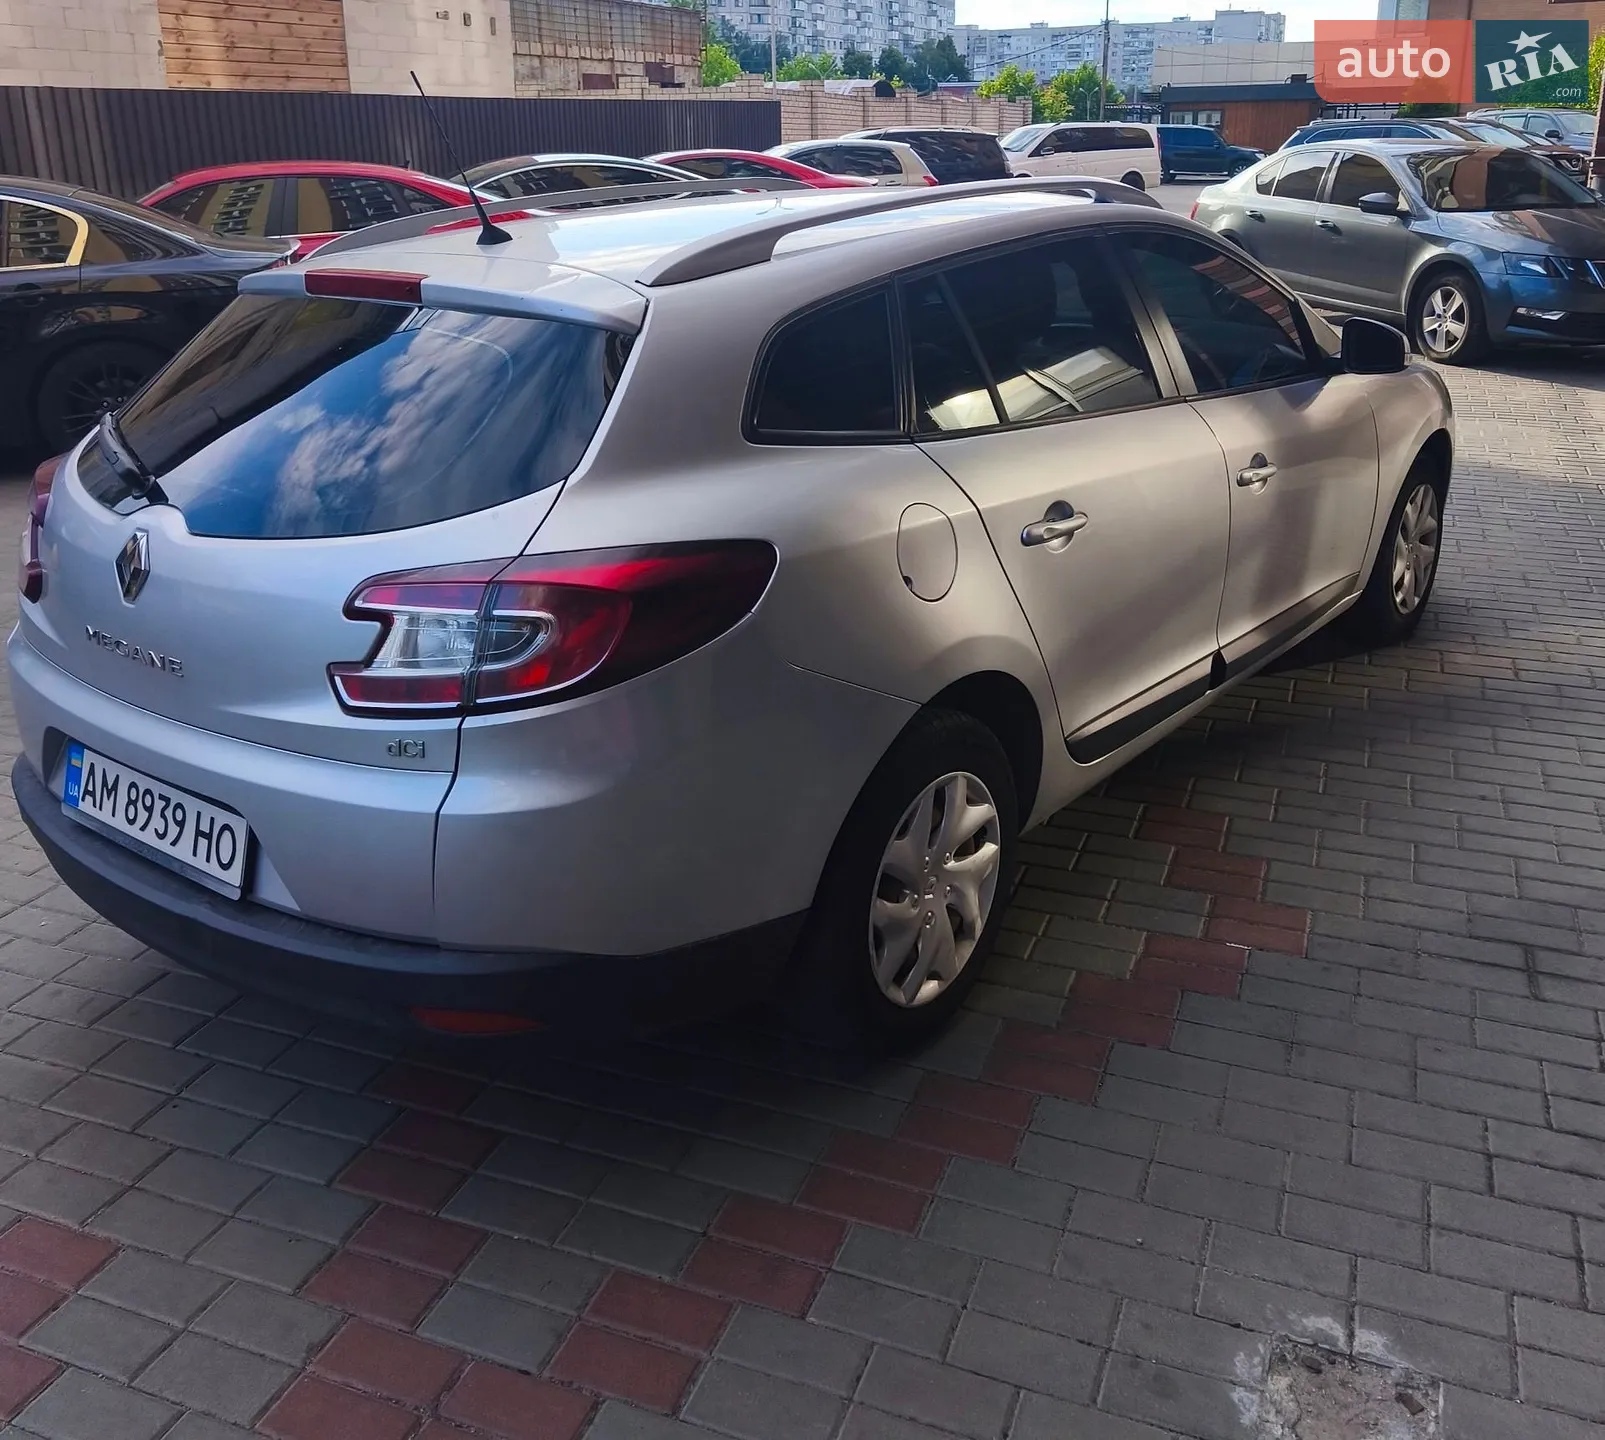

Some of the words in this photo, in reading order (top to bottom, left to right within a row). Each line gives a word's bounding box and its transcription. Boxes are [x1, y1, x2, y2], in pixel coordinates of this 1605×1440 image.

[85, 625, 184, 678] MEGANE
[386, 738, 425, 759] dCi
[68, 786, 80, 798] UA
[81, 762, 119, 818] AM
[125, 781, 187, 847] 8939
[192, 811, 237, 871] HO
